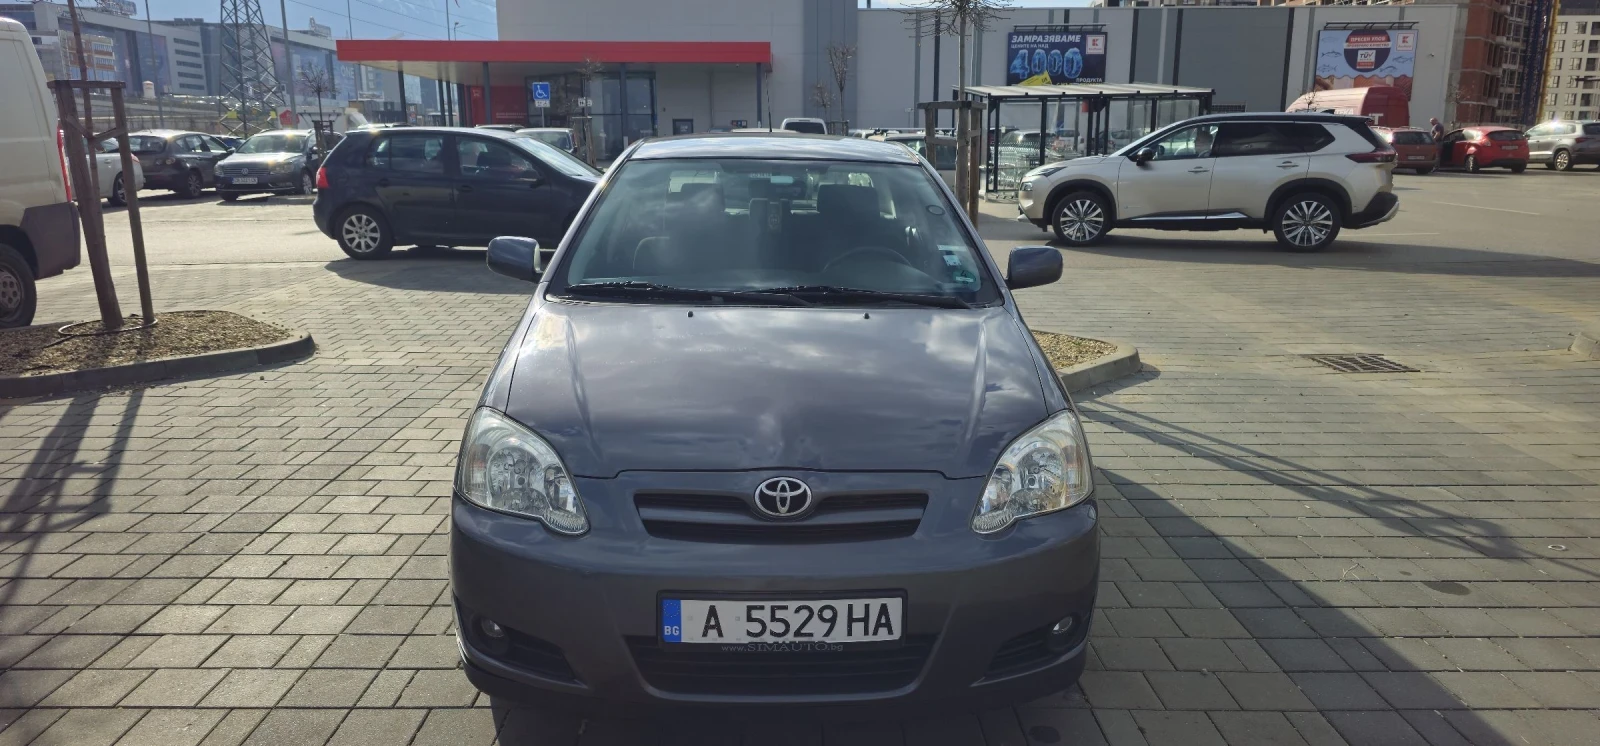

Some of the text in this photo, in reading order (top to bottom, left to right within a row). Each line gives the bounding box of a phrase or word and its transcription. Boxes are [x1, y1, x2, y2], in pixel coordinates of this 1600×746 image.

[1011, 34, 1082, 43] ЗАМРАЗЯВАМЕ
[1010, 47, 1083, 79] 4000
[701, 602, 894, 638] A 5529 HA
[663, 625, 680, 636] BG
[721, 642, 844, 653] www.SIMAUTO.bg
